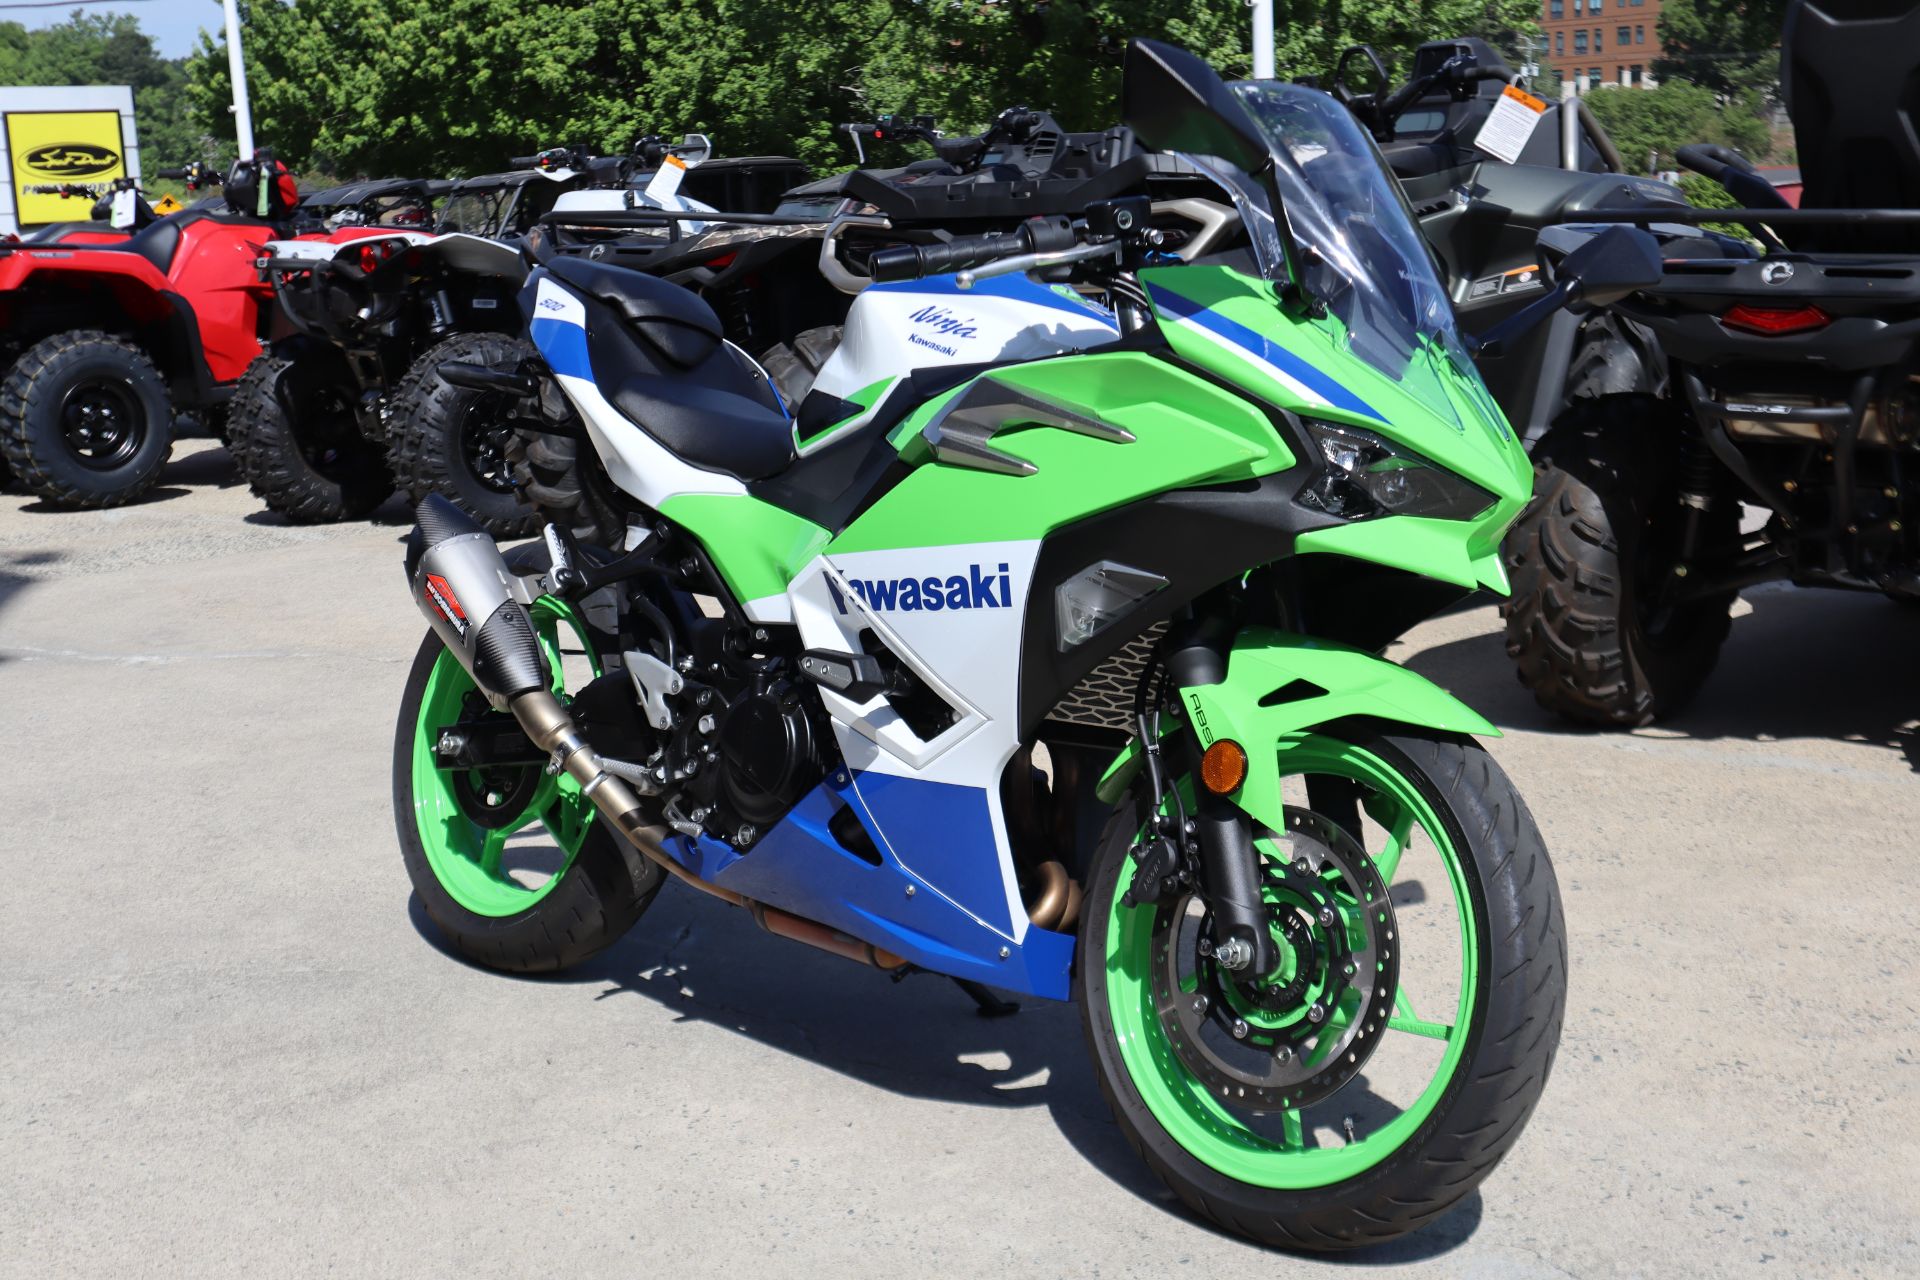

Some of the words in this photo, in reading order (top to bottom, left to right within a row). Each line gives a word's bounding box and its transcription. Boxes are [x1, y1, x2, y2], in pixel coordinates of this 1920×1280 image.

[539, 298, 566, 311] 500
[908, 305, 978, 339] Ninja
[908, 333, 958, 357] Kawasaki
[1189, 693, 1215, 744] ABS
